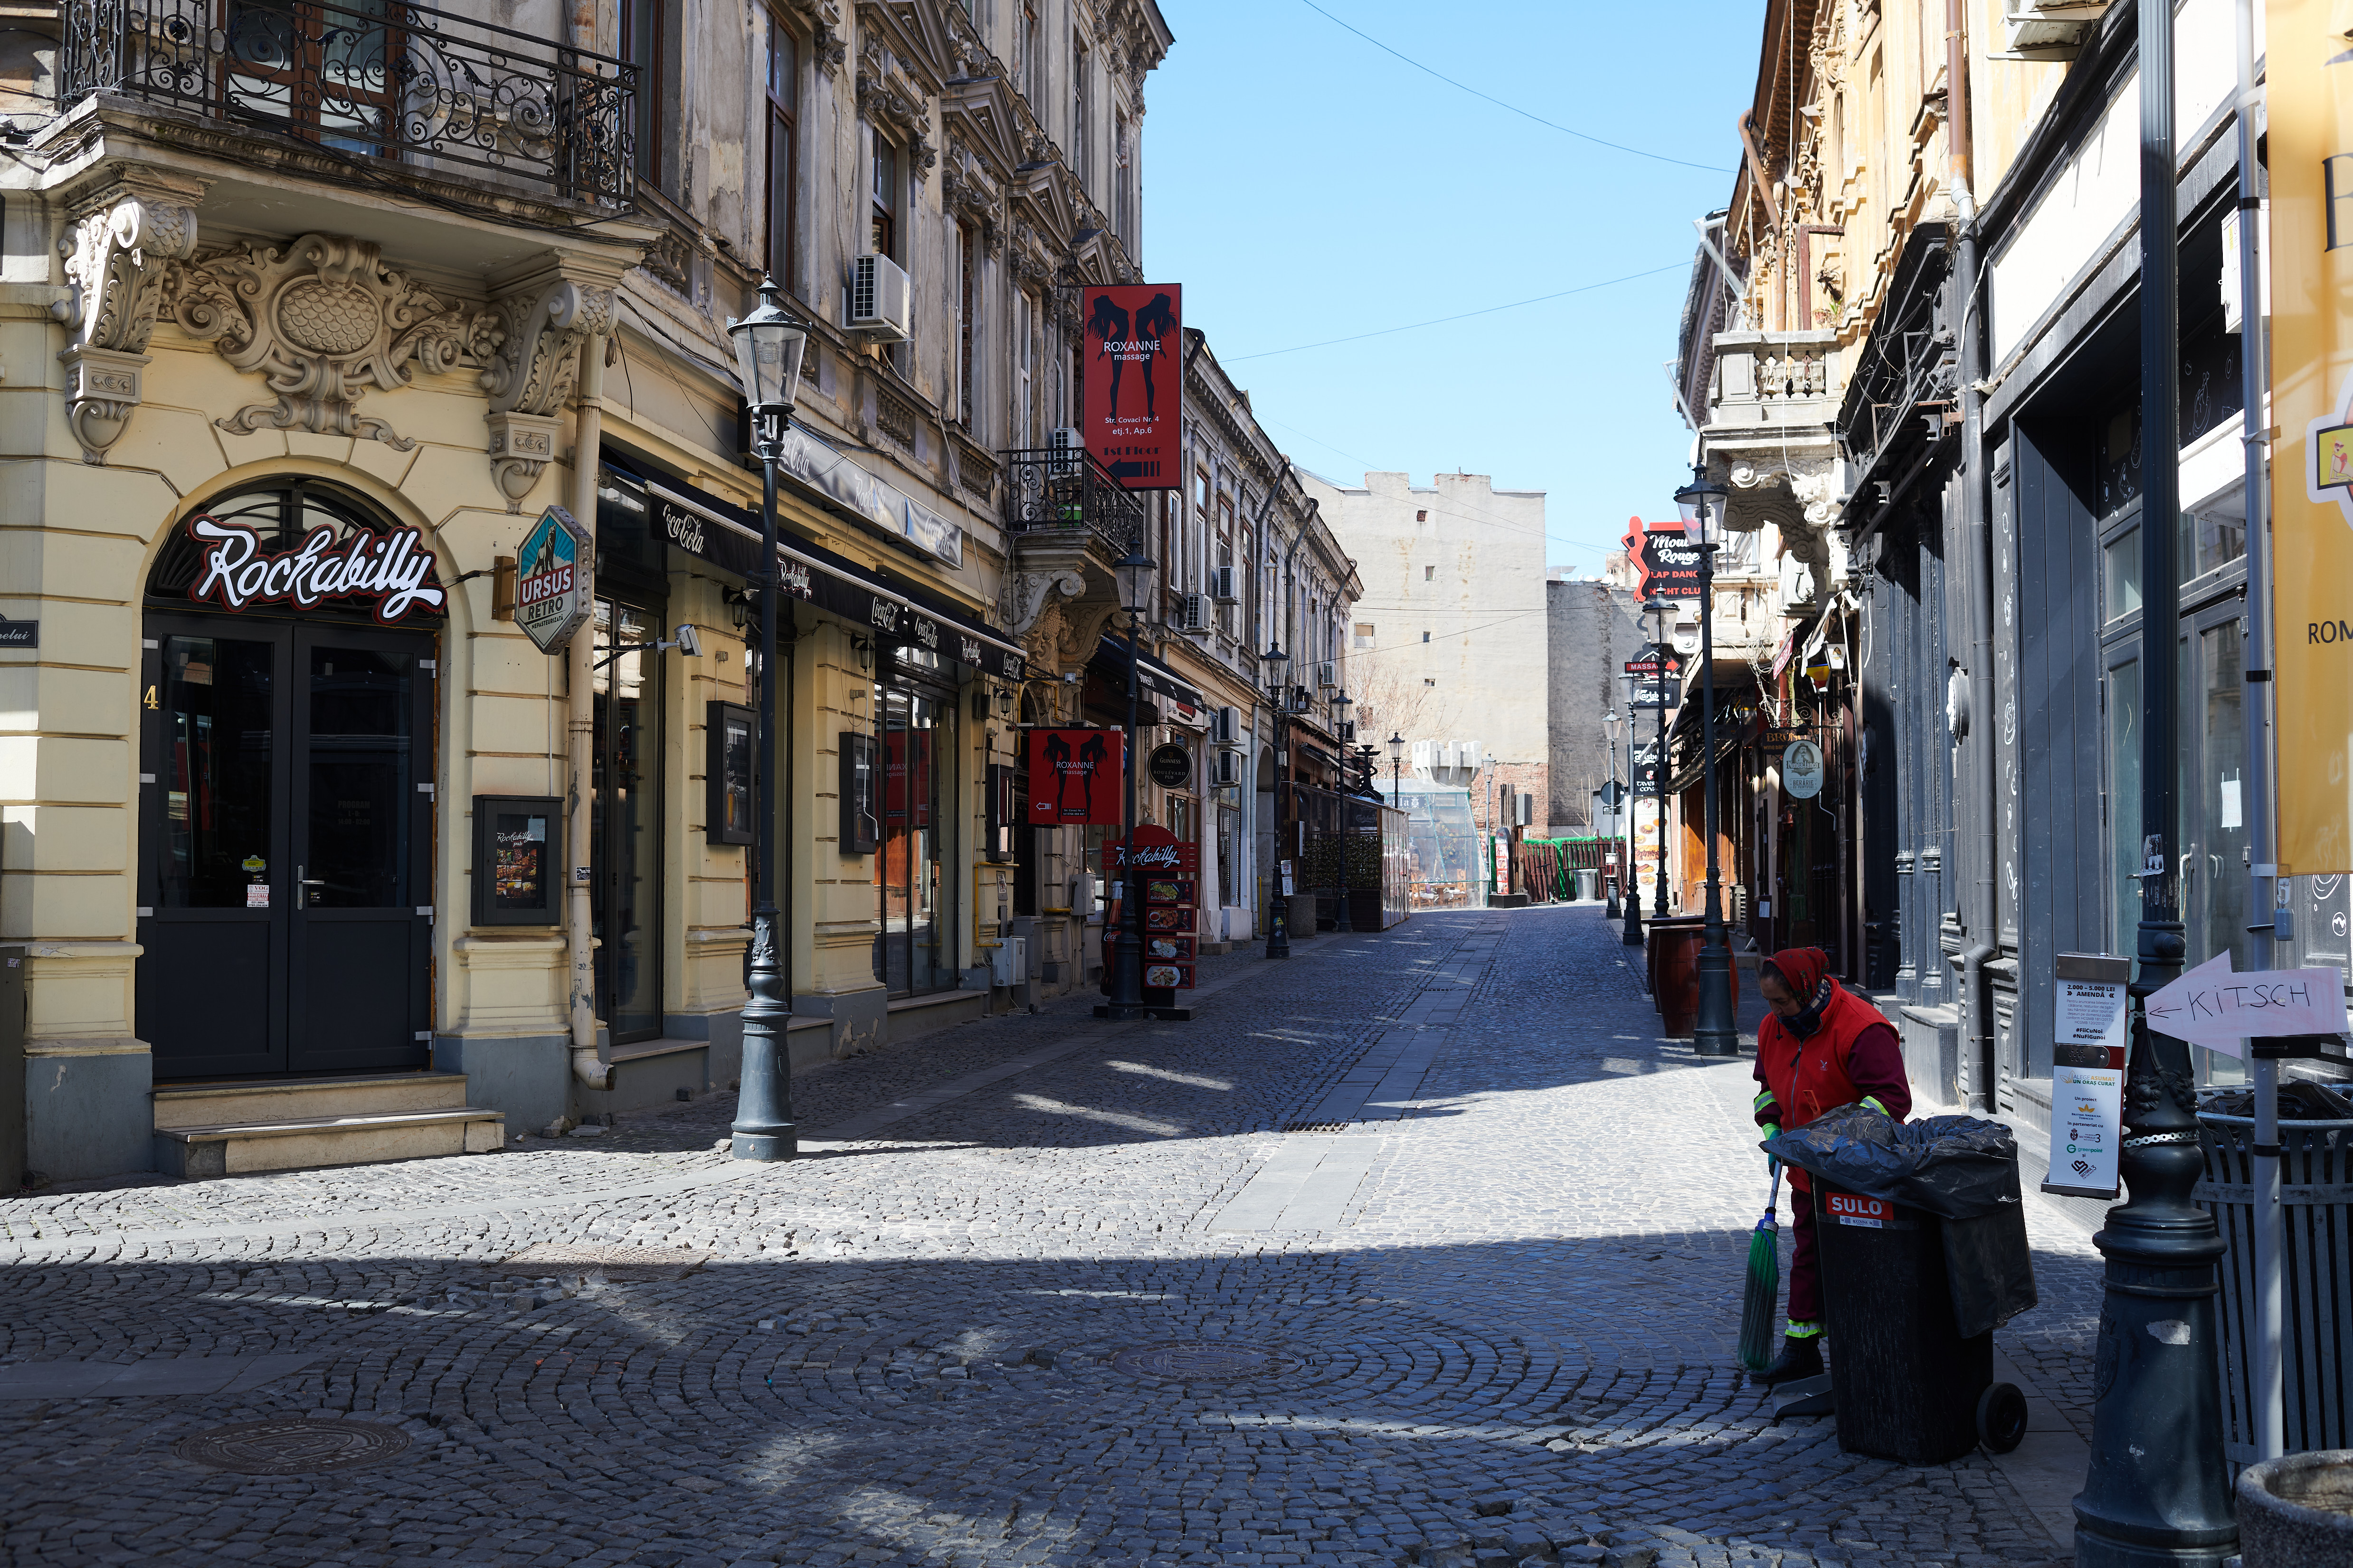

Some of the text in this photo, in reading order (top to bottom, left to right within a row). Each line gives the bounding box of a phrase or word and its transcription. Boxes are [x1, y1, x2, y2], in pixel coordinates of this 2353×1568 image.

[1103, 340, 1160, 352] ROXANNE
[1114, 352, 1150, 362] massage
[1133, 427, 1152, 435] Ap.6
[1103, 446, 1161, 456] 1st Floor
[1658, 548, 1700, 565] Rouge
[192, 518, 445, 620] Rockabilly
[522, 568, 571, 604] URSUS
[528, 596, 563, 620] RETRO
[531, 614, 563, 630] NEPASTEURIZATĂ
[143, 684, 159, 709] 4
[1159, 756, 1181, 764] GUINNESS
[1786, 760, 1803, 769] Nenea
[338, 801, 370, 809] PROGRAM
[497, 831, 533, 843] Rockabilly
[1116, 845, 1180, 868] Rckabilly
[1831, 1196, 1882, 1216] SULO
